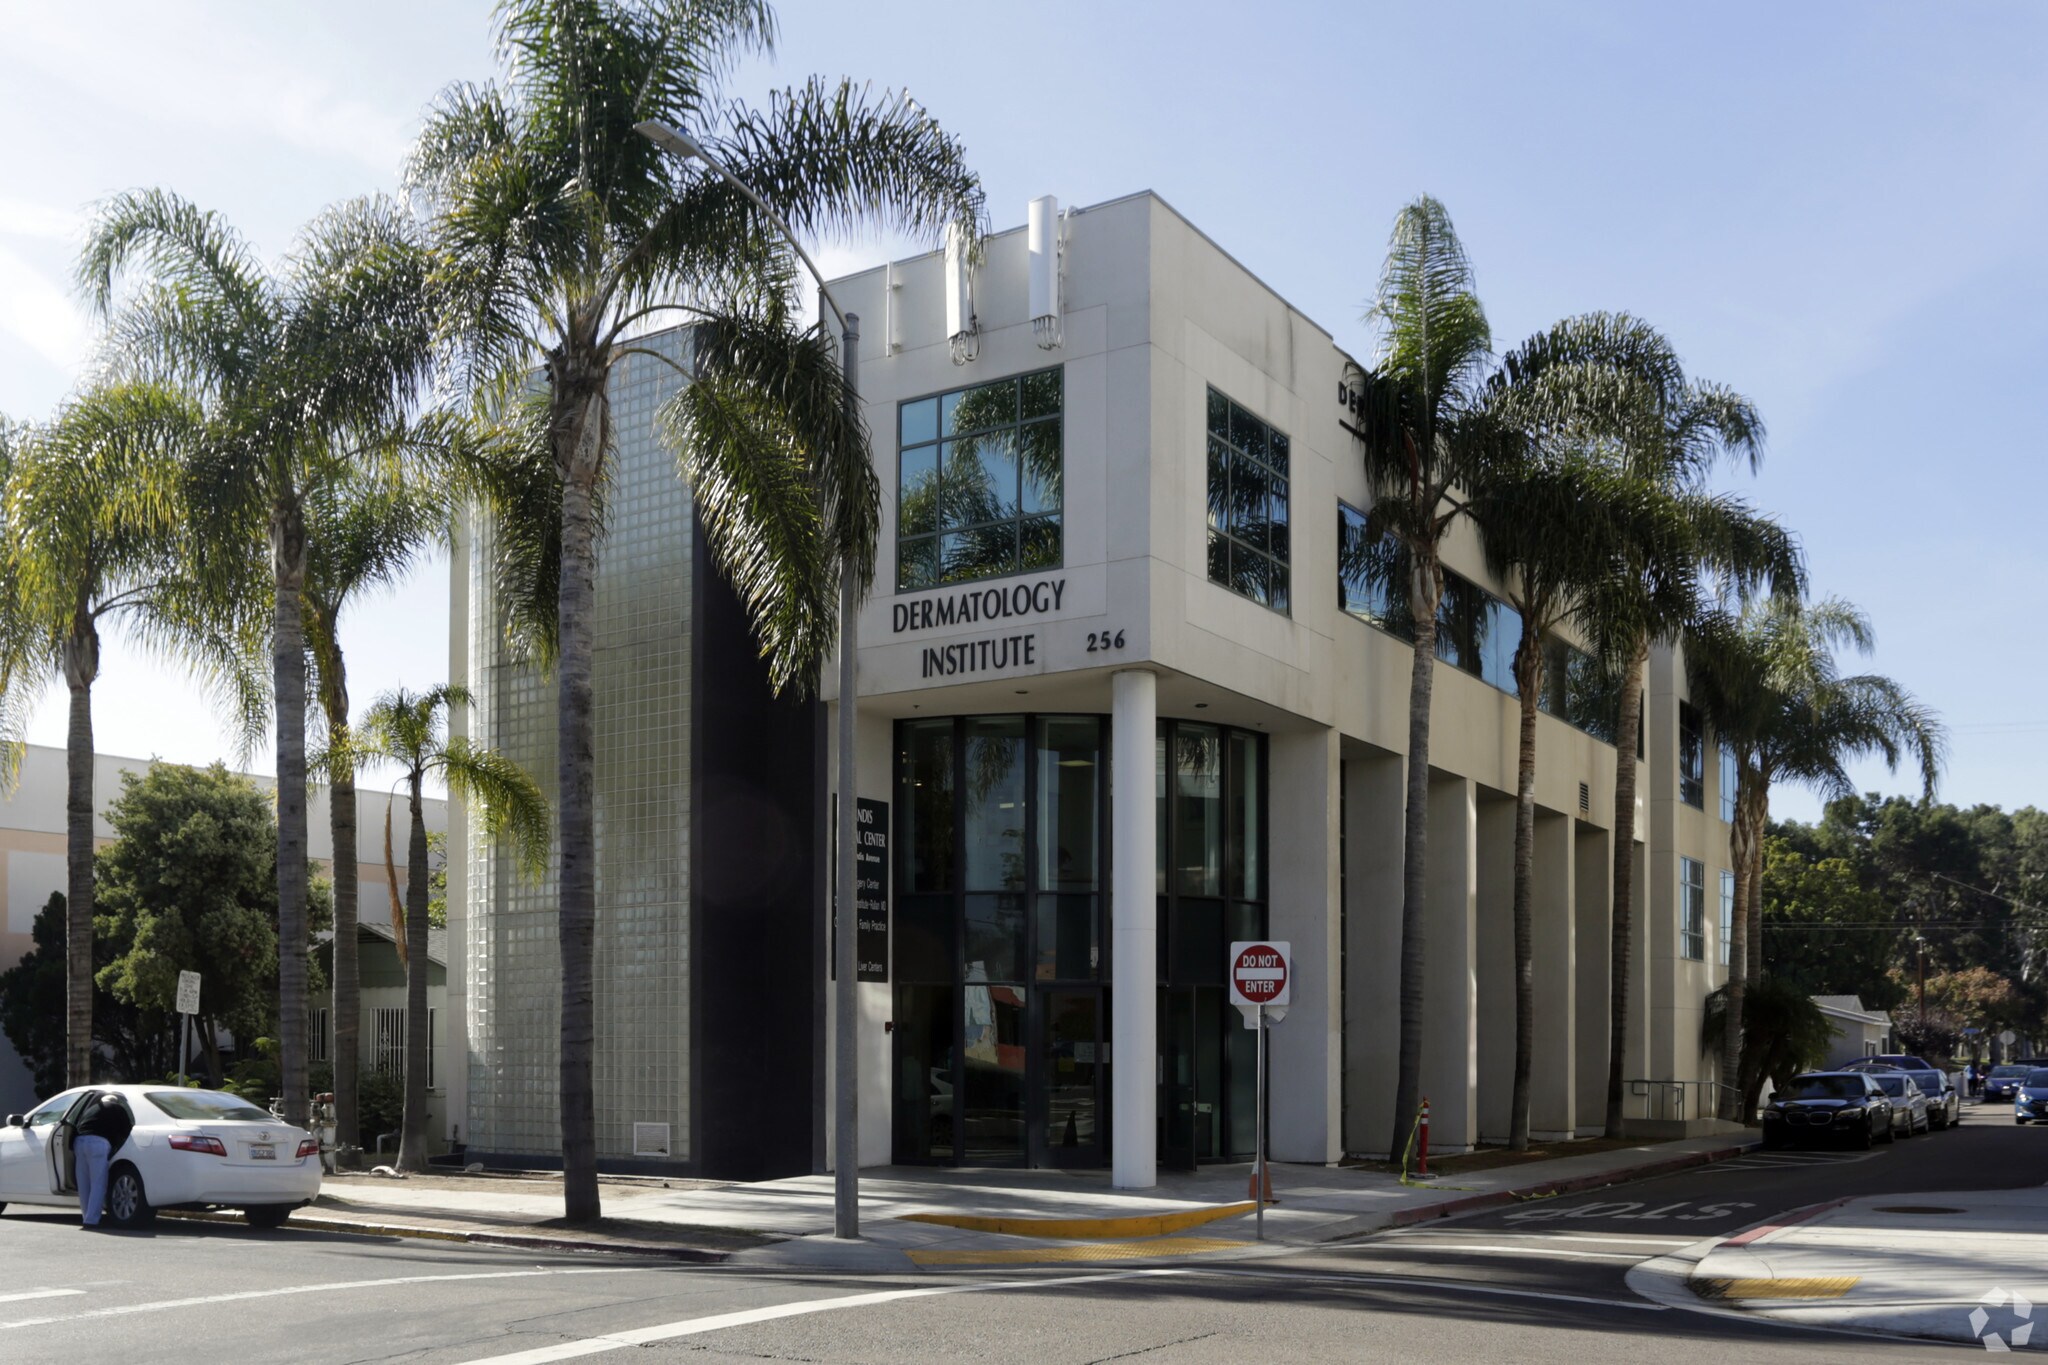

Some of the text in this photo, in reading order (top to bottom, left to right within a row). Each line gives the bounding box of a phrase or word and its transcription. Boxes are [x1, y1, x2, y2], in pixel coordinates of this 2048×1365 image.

[892, 579, 1066, 633] DERMATOLOGY
[1086, 629, 1126, 652] 256
[921, 634, 1035, 678] INSTITUTE
[864, 831, 886, 847] CENTER
[865, 852, 880, 863] Avenue
[866, 878, 880, 890] Center
[859, 918, 886, 932] Family Practice
[1242, 955, 1278, 967] DO NOT
[1245, 981, 1275, 993] ENTER
[1503, 1201, 1756, 1221] STOP
